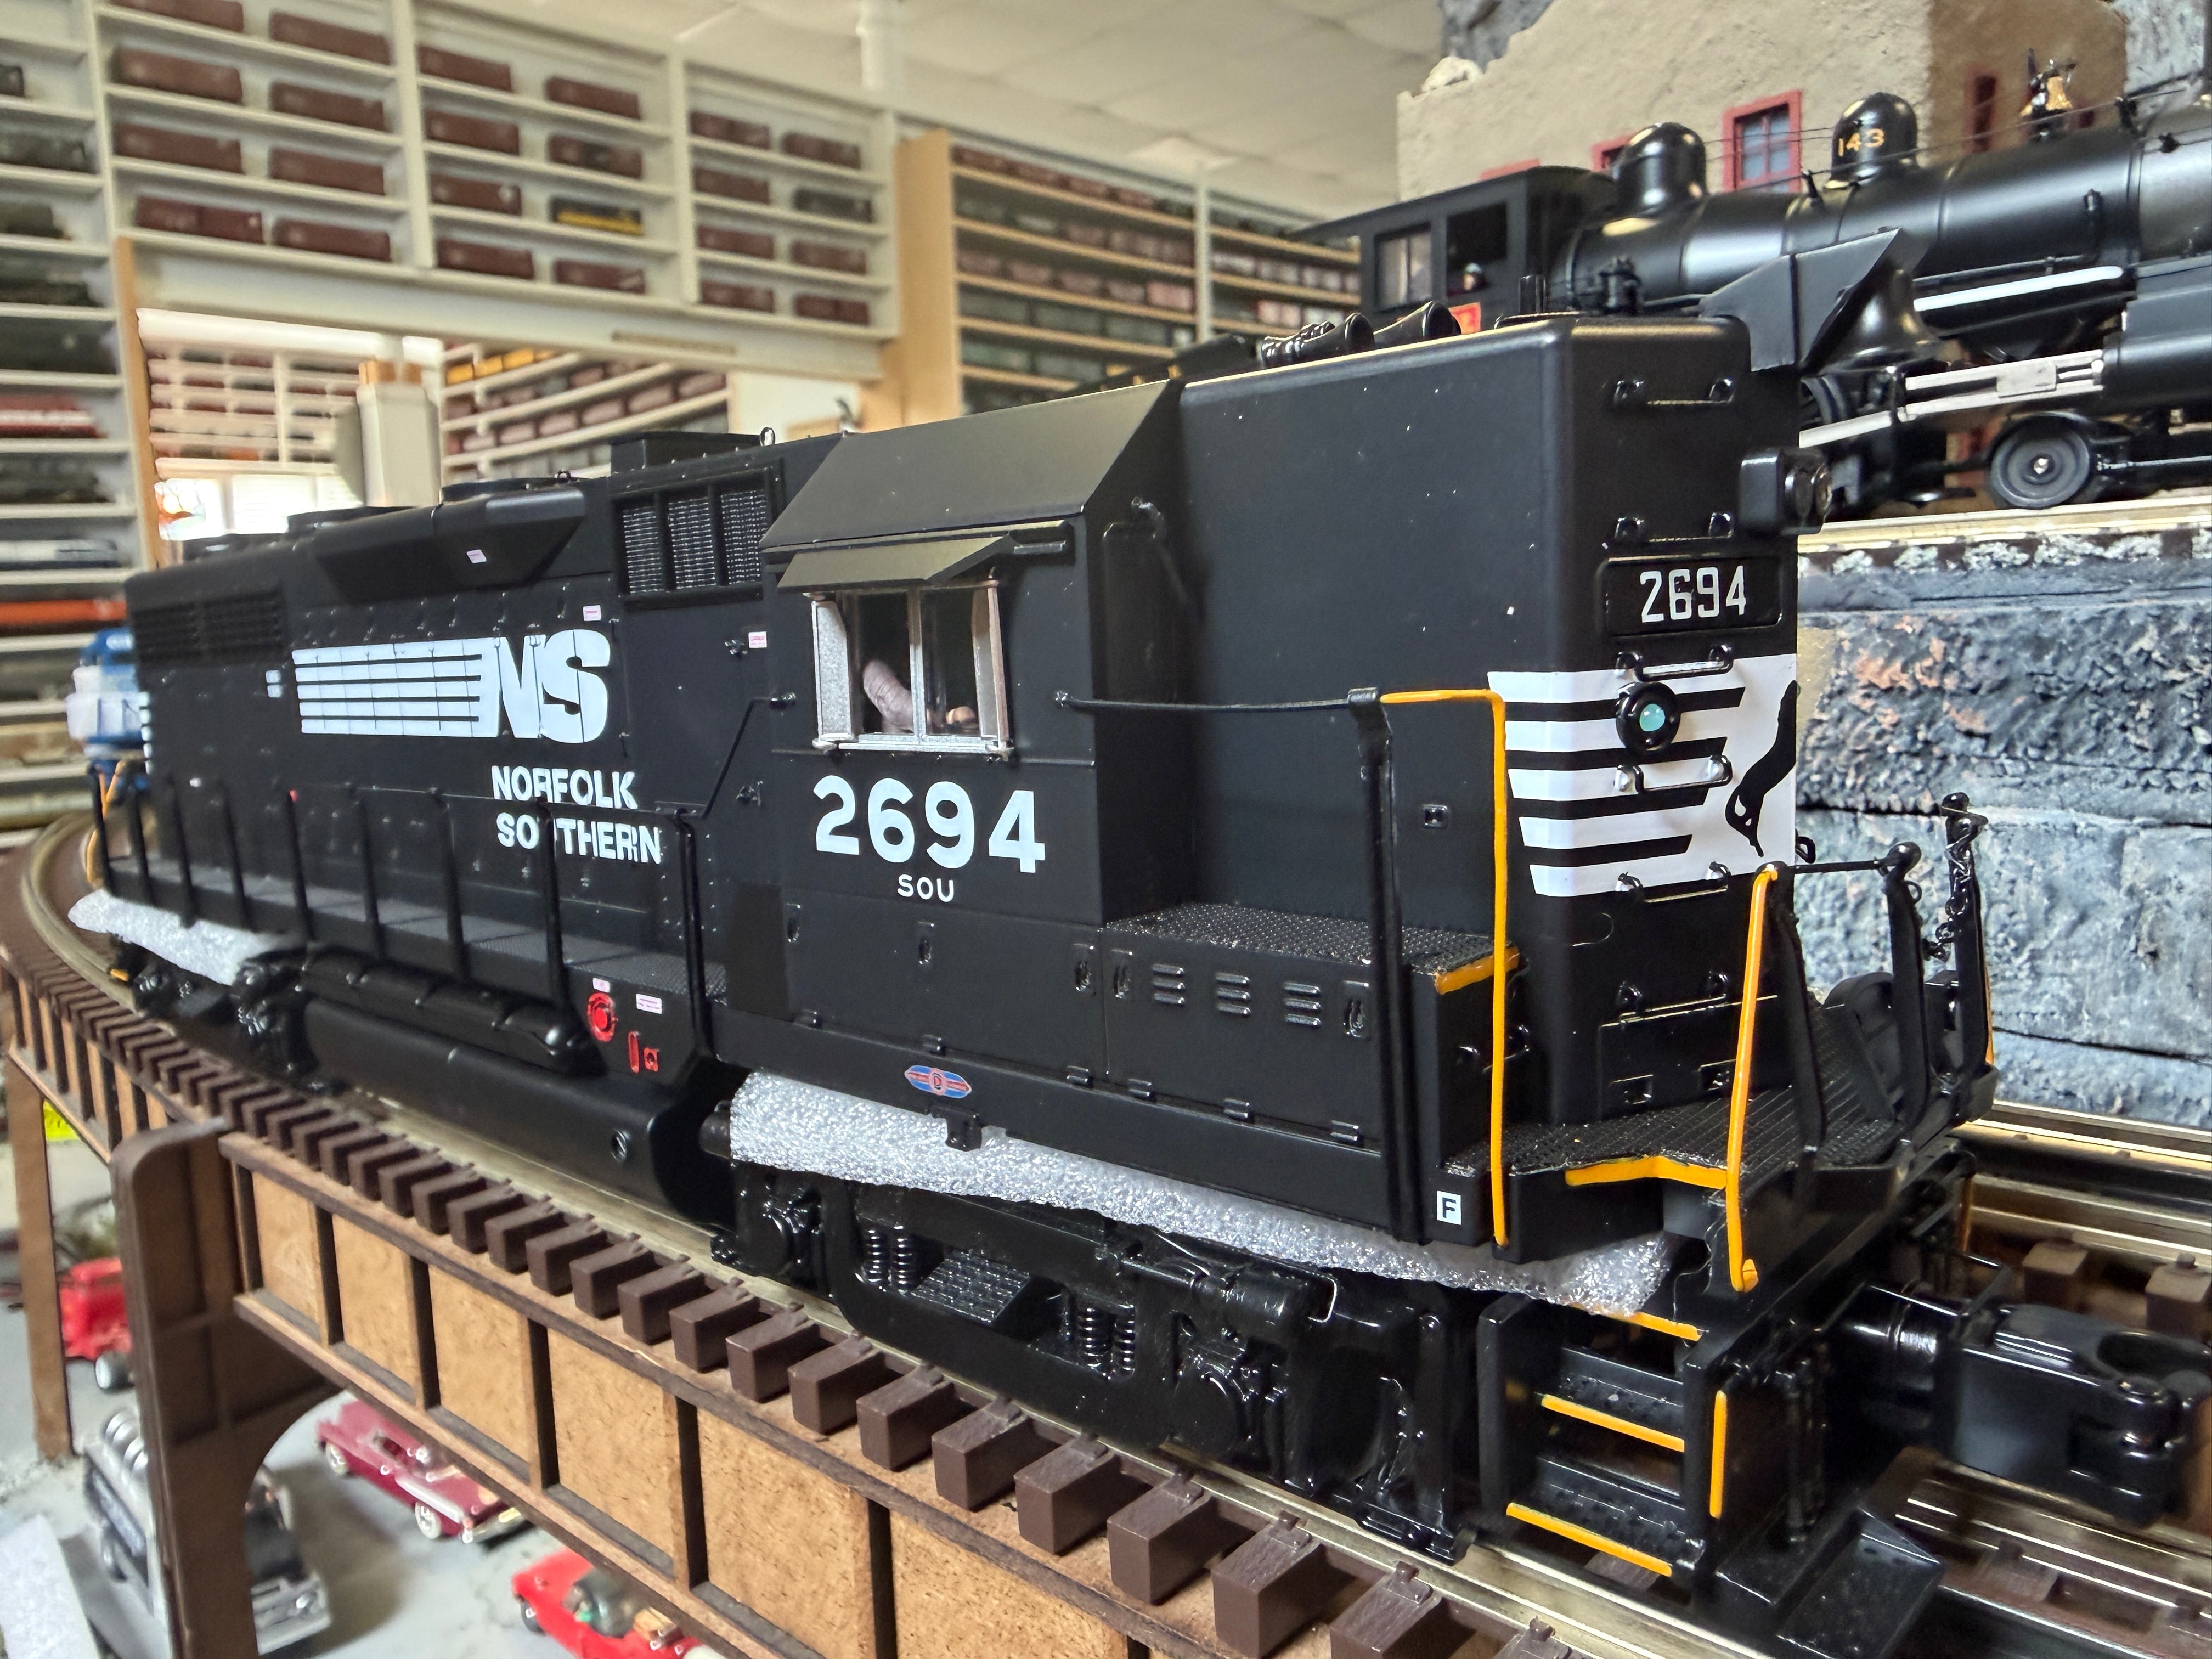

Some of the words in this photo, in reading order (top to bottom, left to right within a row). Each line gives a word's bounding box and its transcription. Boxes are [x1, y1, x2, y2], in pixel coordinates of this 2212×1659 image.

[1838, 128, 1884, 157] 143
[1639, 565, 1747, 623] 2694
[477, 629, 611, 744] NS
[491, 765, 639, 810] NORFOLK
[496, 812, 662, 865] SOTHERN
[812, 775, 1046, 873] 2694
[896, 874, 955, 903] SOU
[1442, 1197, 1457, 1218] F
